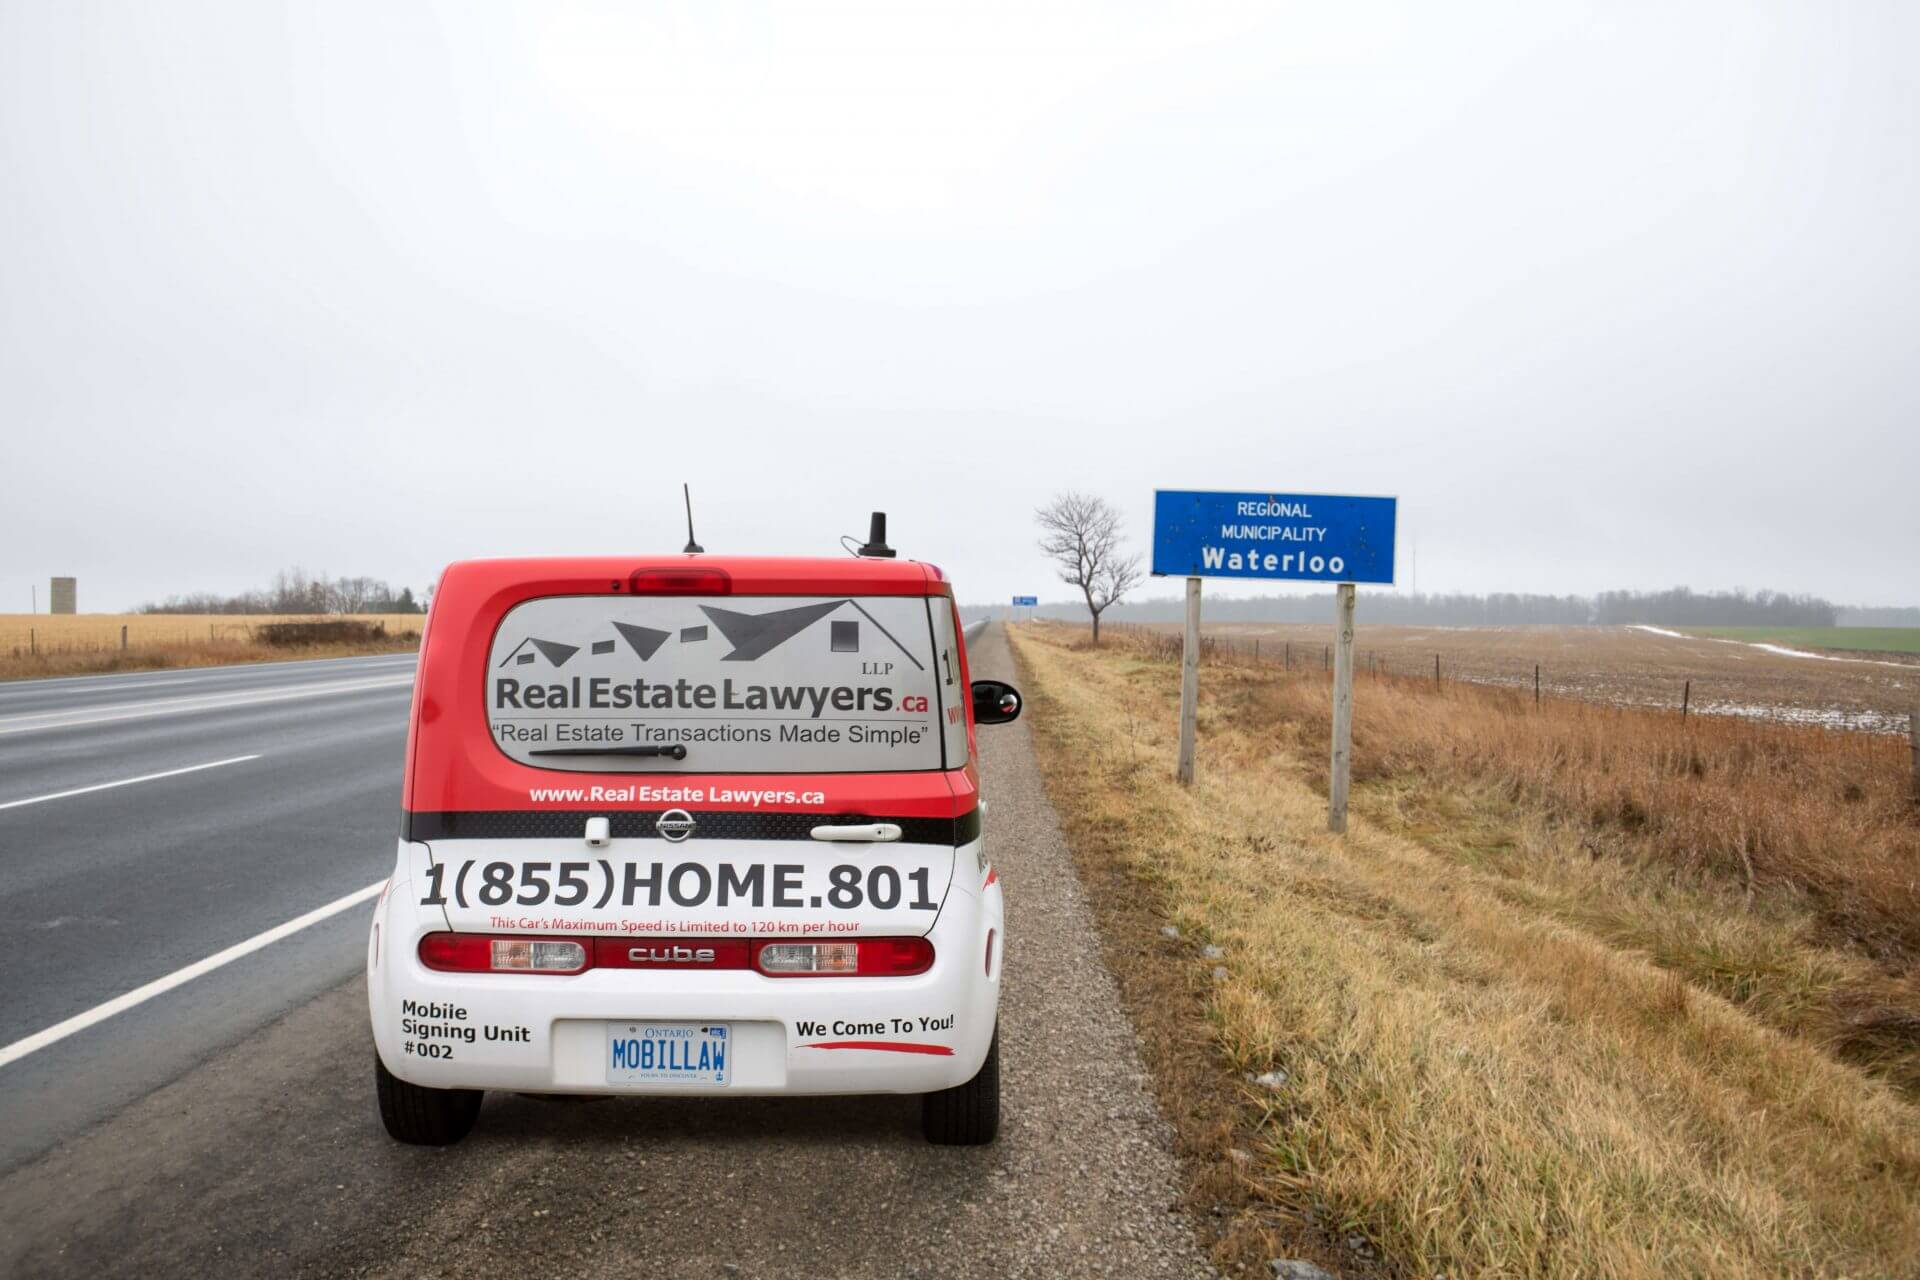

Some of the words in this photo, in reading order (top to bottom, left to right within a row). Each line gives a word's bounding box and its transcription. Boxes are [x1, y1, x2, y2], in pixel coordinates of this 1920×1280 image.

[1237, 501, 1313, 518] REGIONAL
[1221, 524, 1328, 542] MUNICIPALITY
[1202, 547, 1346, 574] Waterloo
[862, 662, 894, 675] LLP
[556, 724, 624, 742] Estate
[630, 724, 772, 742] Transactions
[779, 724, 841, 743] Made
[639, 788, 704, 802] Estate
[709, 788, 825, 807] Lawyers.ca
[490, 916, 515, 929] This
[552, 918, 617, 931] Maximum
[621, 919, 662, 933] Speed
[666, 920, 676, 932] is
[679, 920, 729, 932] Limited
[733, 922, 747, 933] to
[751, 921, 775, 932] 120
[778, 921, 799, 932] km
[803, 922, 825, 934] per
[828, 919, 860, 932] hour
[628, 946, 715, 962] cube
[402, 999, 467, 1020] Mobile
[402, 1018, 476, 1043] Signing
[484, 1024, 531, 1042] Unit
[796, 1020, 826, 1036] We
[832, 1020, 886, 1036] Come
[890, 1018, 913, 1034] To
[918, 1014, 954, 1032] You!
[404, 1040, 453, 1059] #002
[612, 1039, 726, 1070] MOBILLAW
